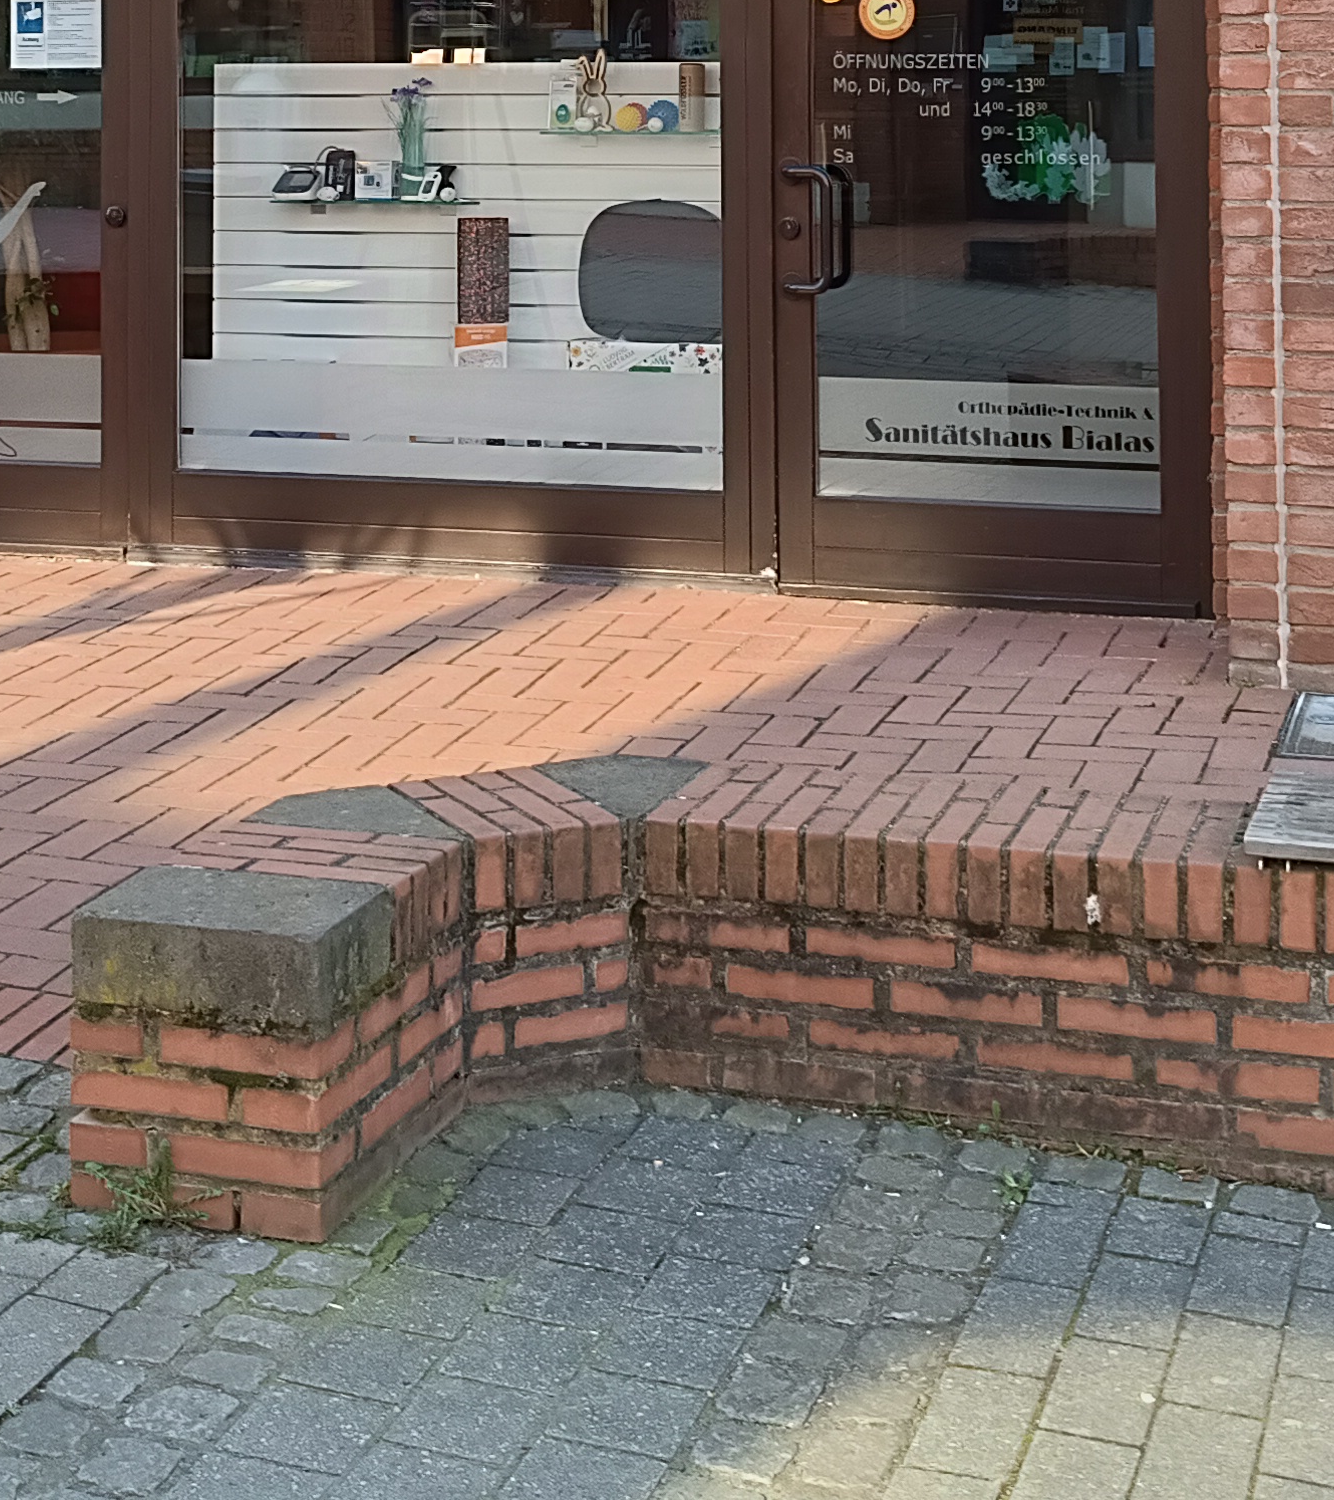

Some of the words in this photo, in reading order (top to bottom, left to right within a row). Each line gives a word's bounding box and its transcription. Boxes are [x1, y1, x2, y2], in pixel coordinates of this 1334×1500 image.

[833, 52, 988, 69] ÖFFNUNGSZEITEN
[833, 78, 861, 96] Mo,
[869, 78, 890, 96] Di,
[898, 78, 925, 96] Do,
[919, 102, 951, 117] und
[833, 126, 852, 141] Mi
[833, 149, 854, 163] Sa
[981, 149, 1101, 166] geschlossen
[958, 401, 1137, 420] Orthopädie-Technik
[865, 417, 1052, 449] Sanitätshaus
[1062, 426, 1155, 453] Bialas
